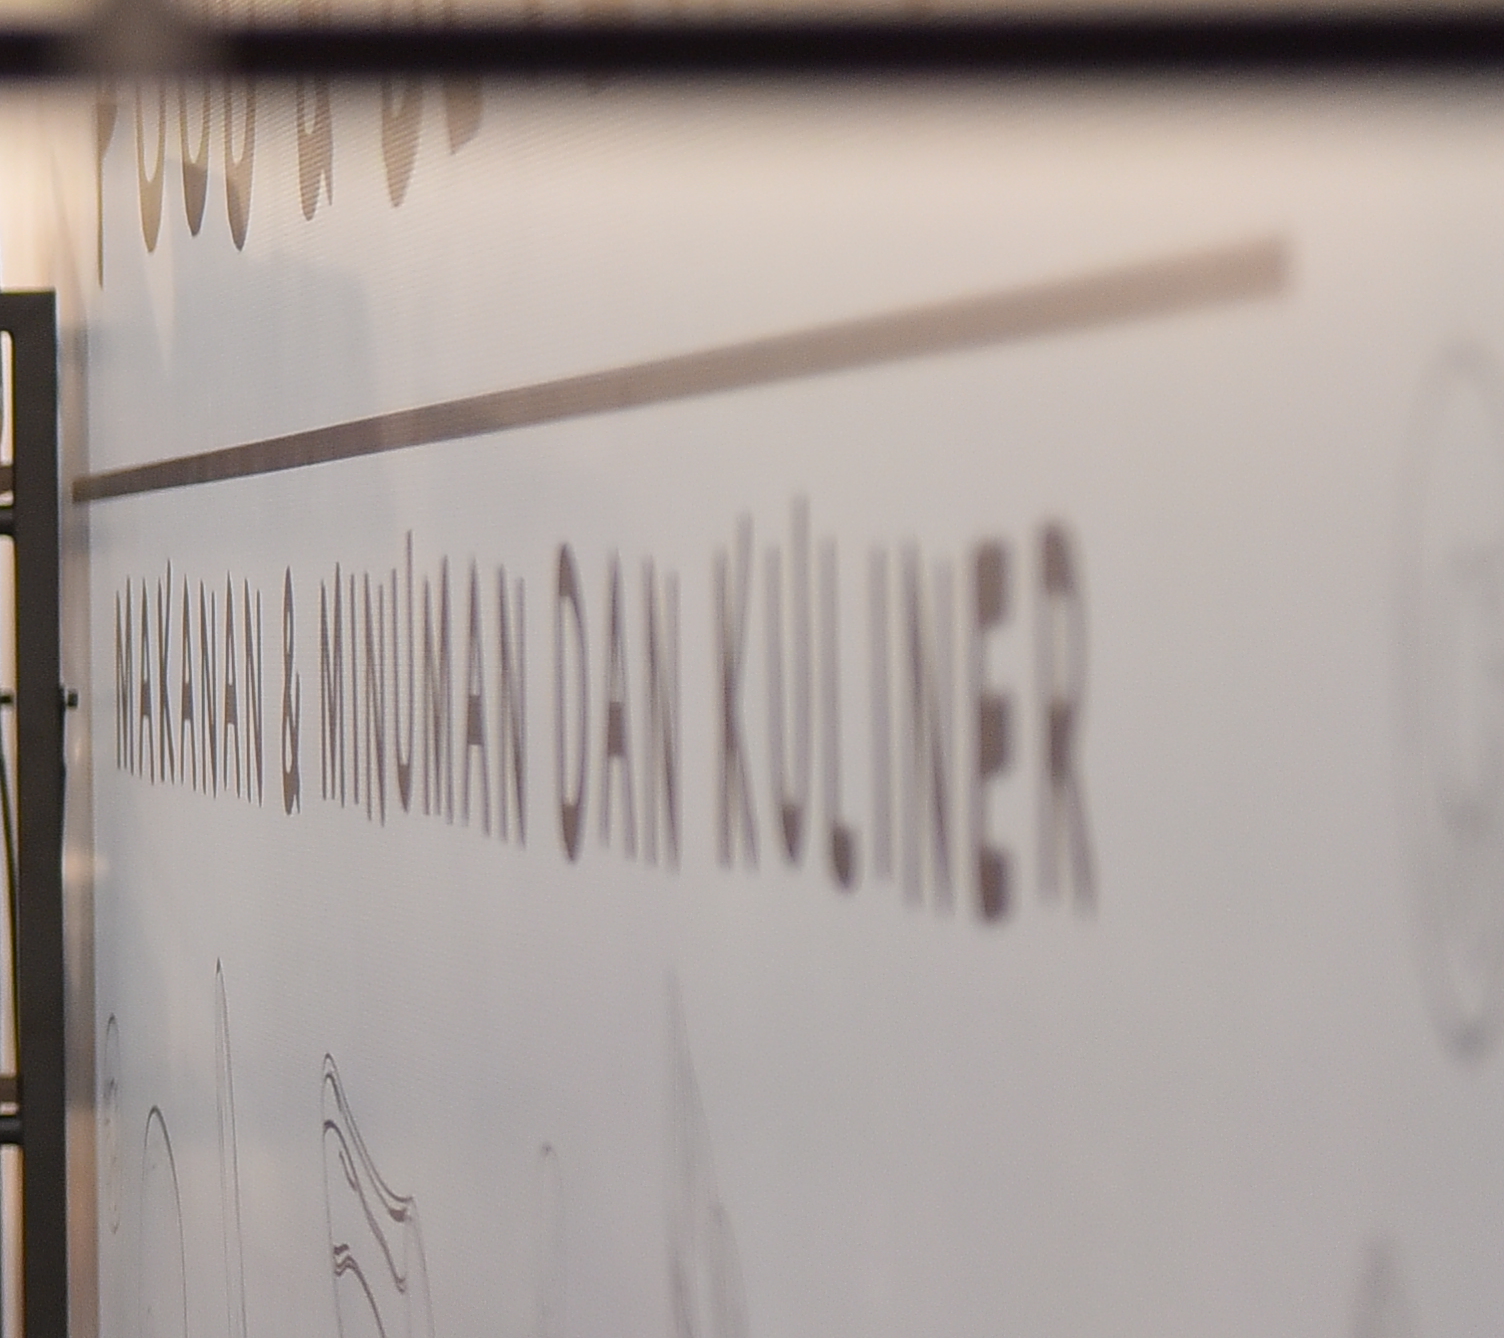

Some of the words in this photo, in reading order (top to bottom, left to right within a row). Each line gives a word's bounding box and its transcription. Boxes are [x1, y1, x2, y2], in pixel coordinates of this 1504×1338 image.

[114, 558, 264, 809] MAKANAN
[282, 564, 301, 817] &
[319, 528, 527, 849] MINUMAN
[554, 539, 682, 873] DAN
[711, 494, 1098, 923] KULINER
